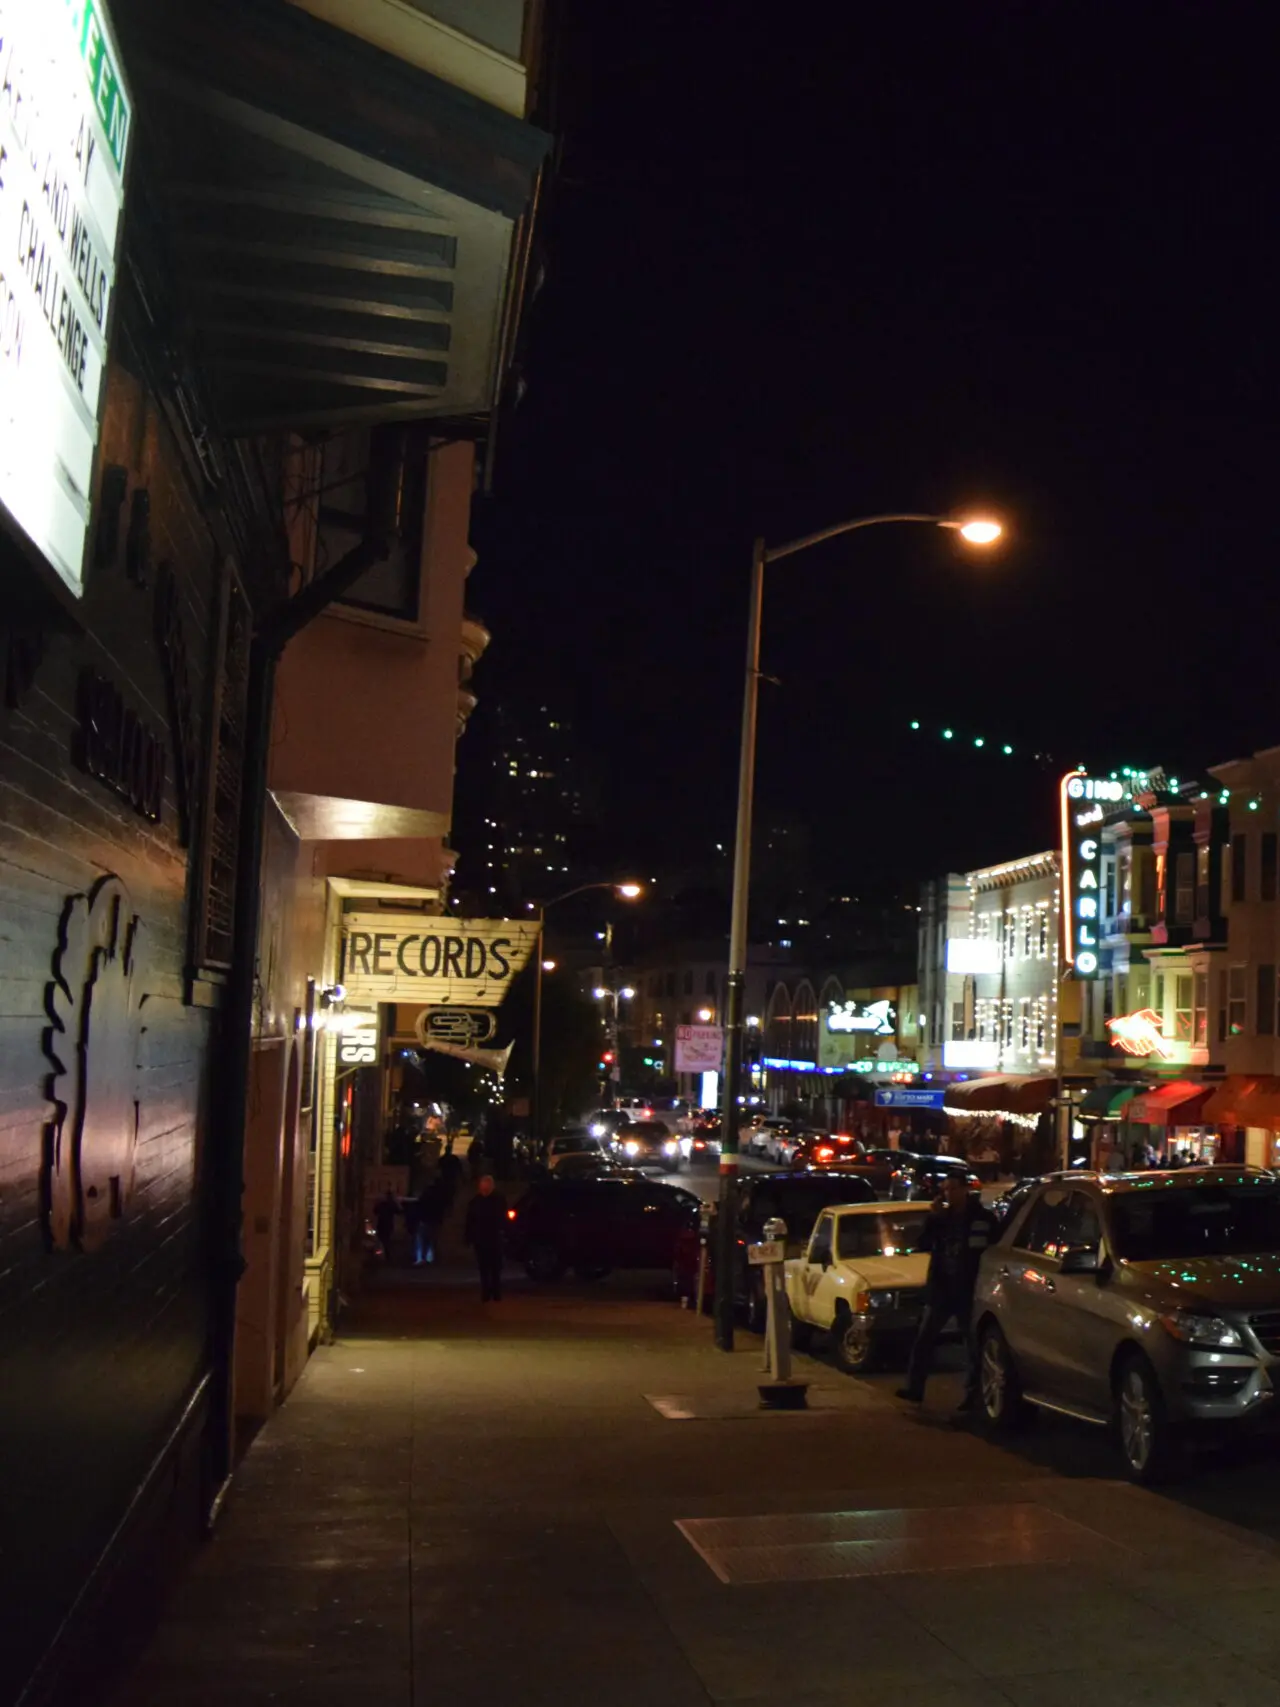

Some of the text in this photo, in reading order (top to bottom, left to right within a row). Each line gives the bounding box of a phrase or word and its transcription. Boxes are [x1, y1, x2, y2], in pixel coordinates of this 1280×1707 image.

[18, 198, 89, 394] CHALLENGE
[68, 202, 109, 328] WELLS
[1068, 778, 1123, 800] GINO
[350, 932, 511, 980] RECORDS
[1077, 840, 1097, 973] CARLO
